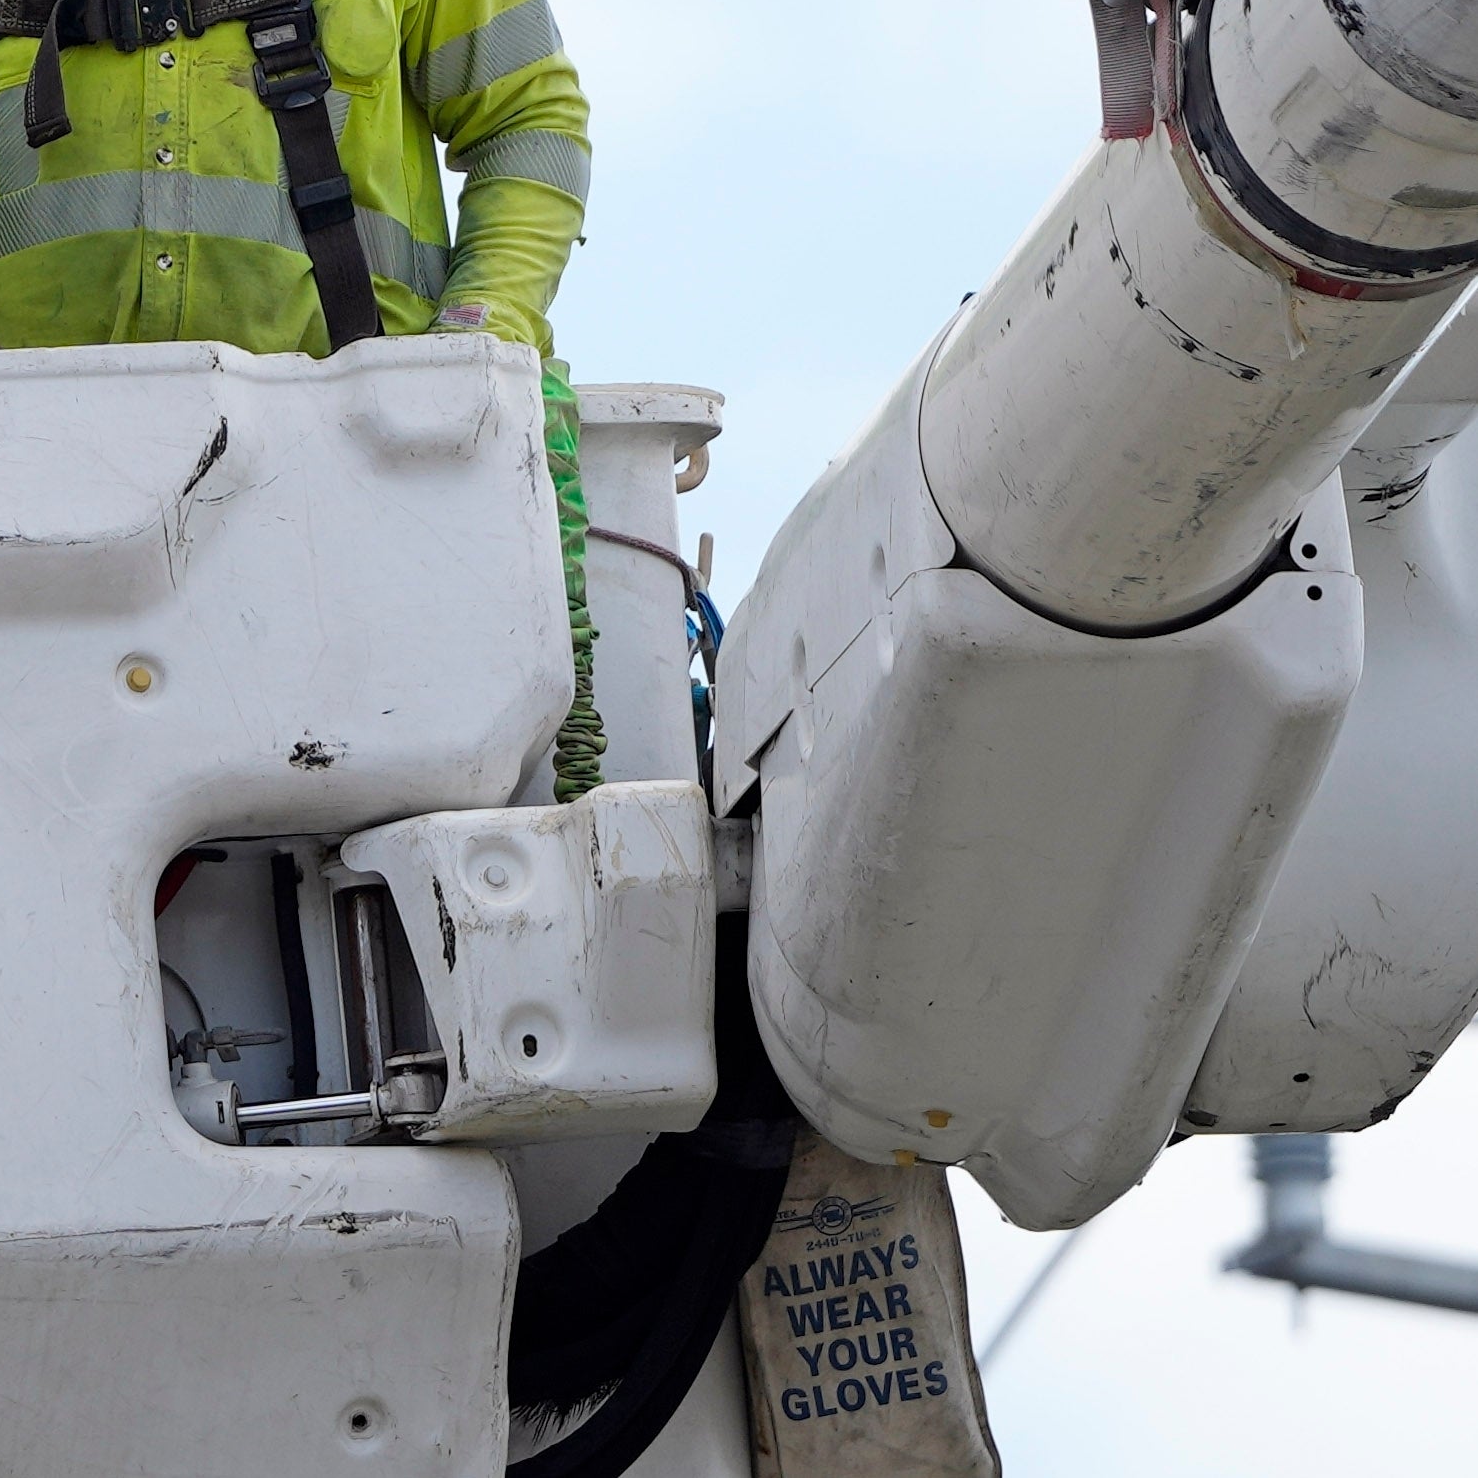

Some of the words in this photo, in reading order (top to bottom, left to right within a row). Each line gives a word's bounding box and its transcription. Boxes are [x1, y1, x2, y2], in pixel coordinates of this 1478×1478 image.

[774, 1209, 798, 1220] TEX
[763, 1234, 919, 1297] ALWAYS
[786, 1283, 912, 1338] WEAR
[796, 1327, 918, 1377] YOUR
[780, 1360, 948, 1421] GLOVES
